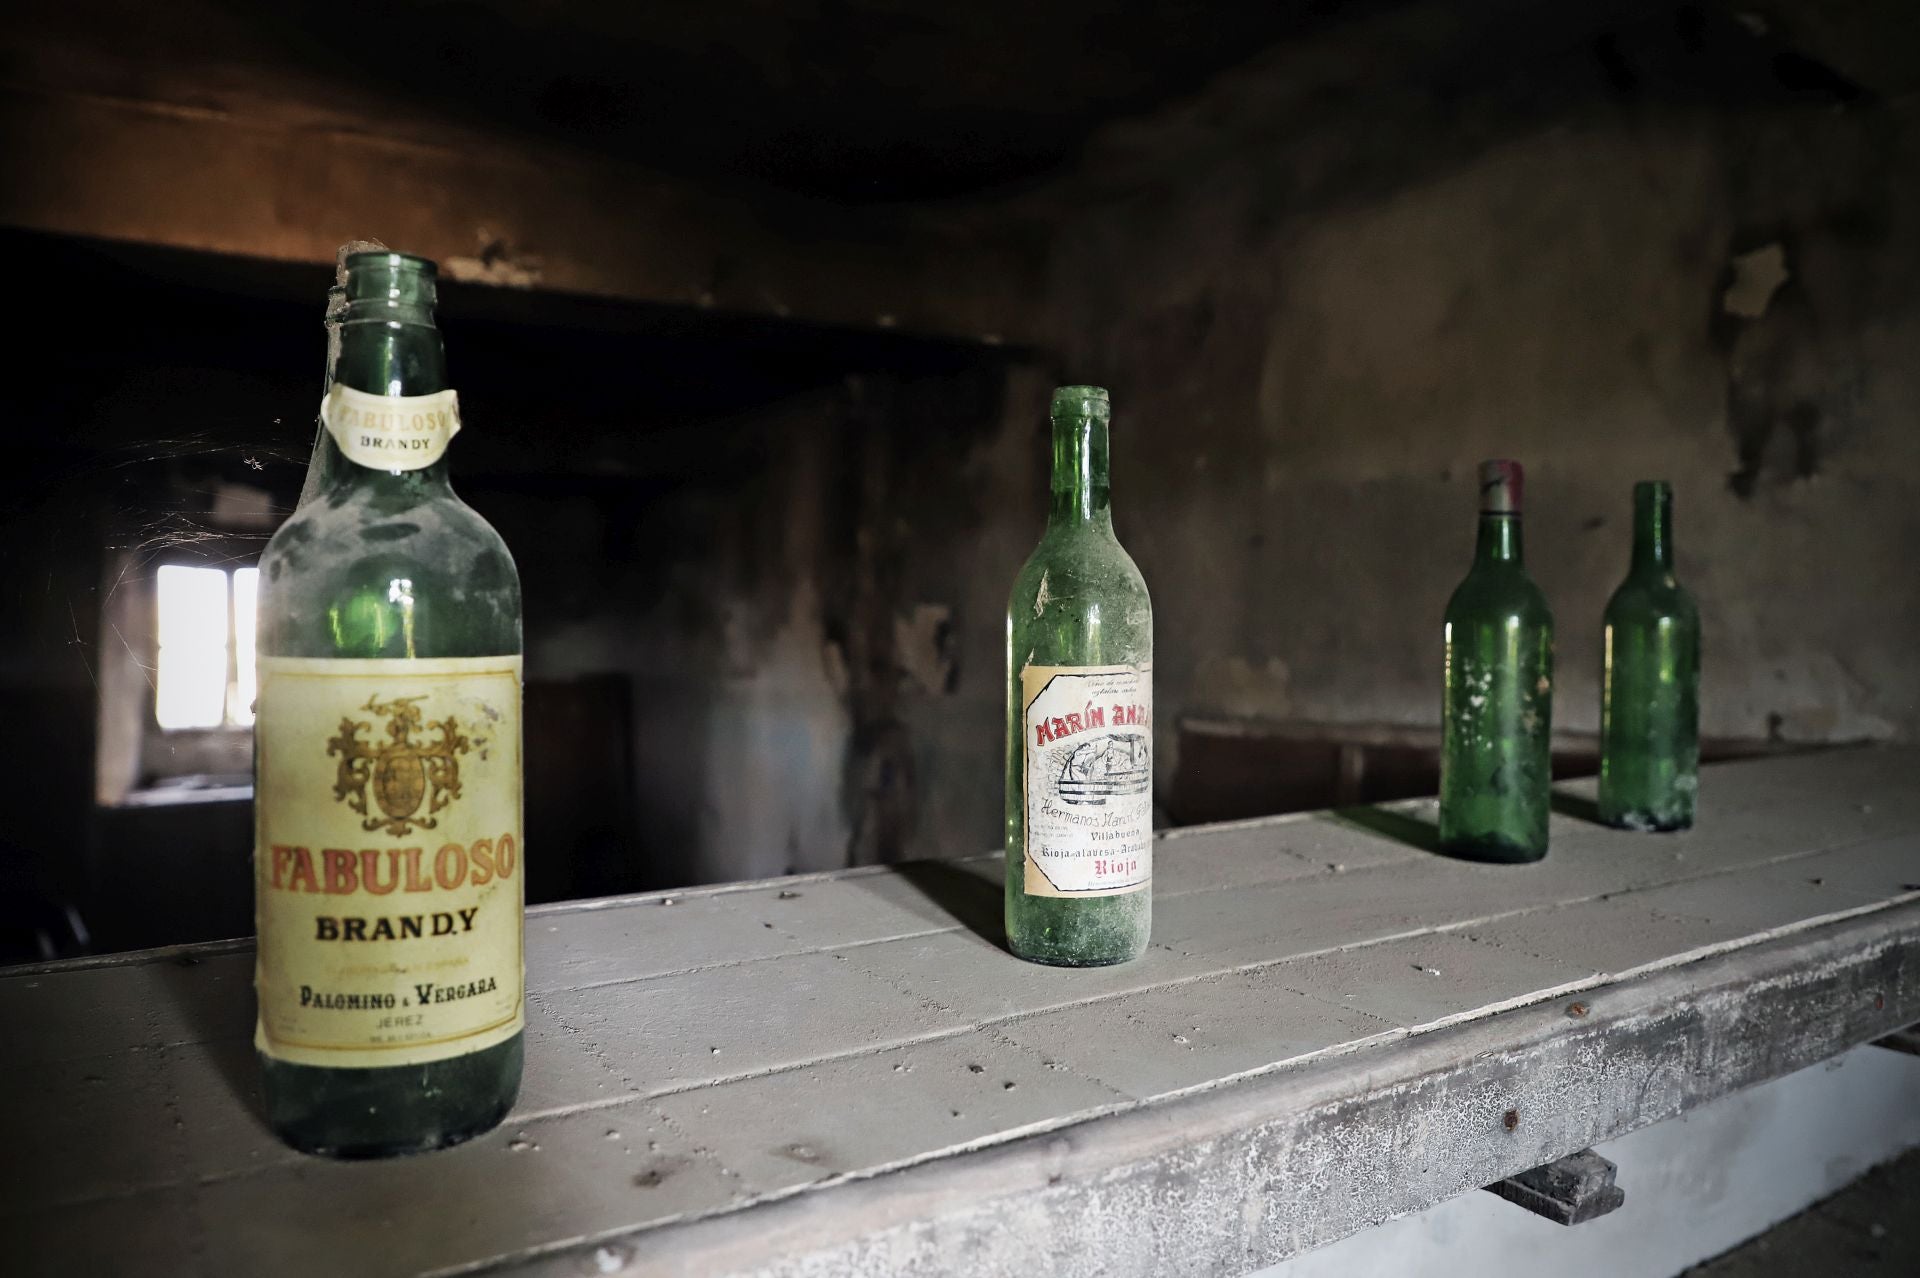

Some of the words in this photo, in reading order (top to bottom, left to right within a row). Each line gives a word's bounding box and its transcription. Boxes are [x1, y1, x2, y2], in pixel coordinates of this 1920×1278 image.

[360, 435, 431, 450] BRANDY
[1036, 700, 1105, 747] MARÍN
[1041, 797, 1100, 828] Hermanos
[270, 832, 516, 896] FABULOSO
[1094, 859, 1137, 877] Rioja
[315, 906, 479, 942] BRANDY
[300, 984, 396, 1010] PALOMINO
[414, 976, 497, 1006] VERGARA
[375, 1013, 425, 1029] JEREZ
